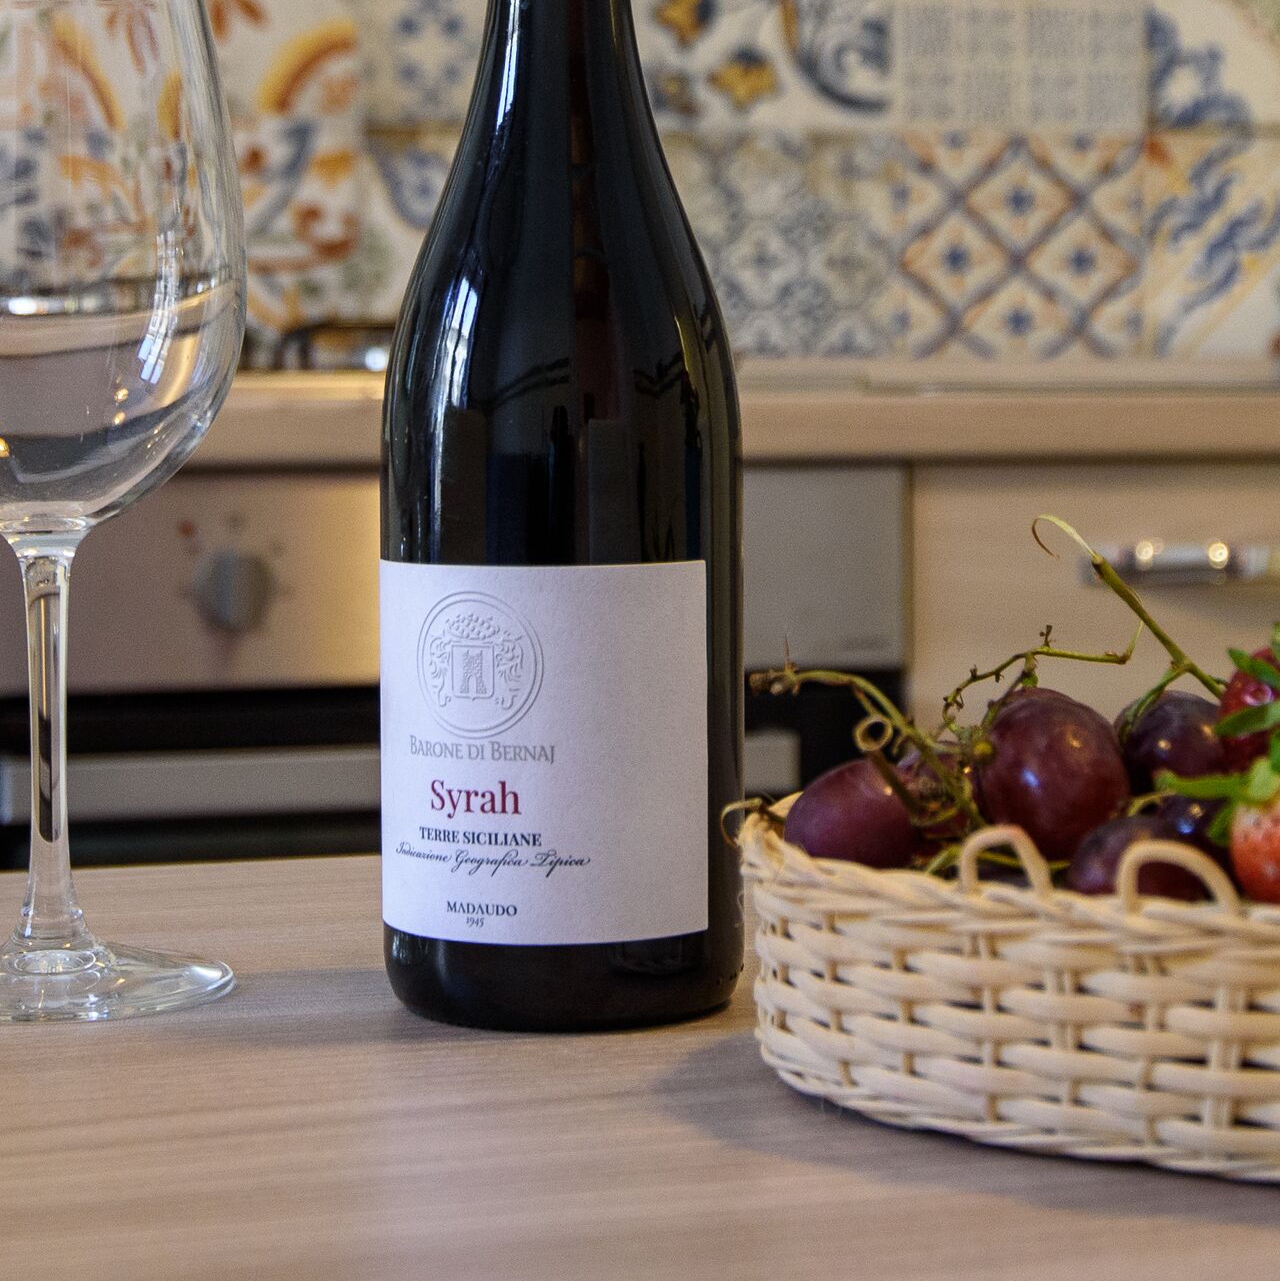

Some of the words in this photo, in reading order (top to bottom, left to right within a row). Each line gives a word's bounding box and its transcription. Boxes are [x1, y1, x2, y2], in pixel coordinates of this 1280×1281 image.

[409, 734, 463, 760] BARONE
[467, 742, 486, 761] DI
[490, 741, 556, 766] BERNAJ
[430, 779, 523, 819] Syrah
[419, 826, 460, 845] TERRE
[462, 831, 542, 847] SICILIANE
[395, 841, 452, 864] Indicazione
[451, 849, 528, 877] Geografica
[530, 849, 591, 878] Tipica
[446, 900, 518, 917] MADAUDO
